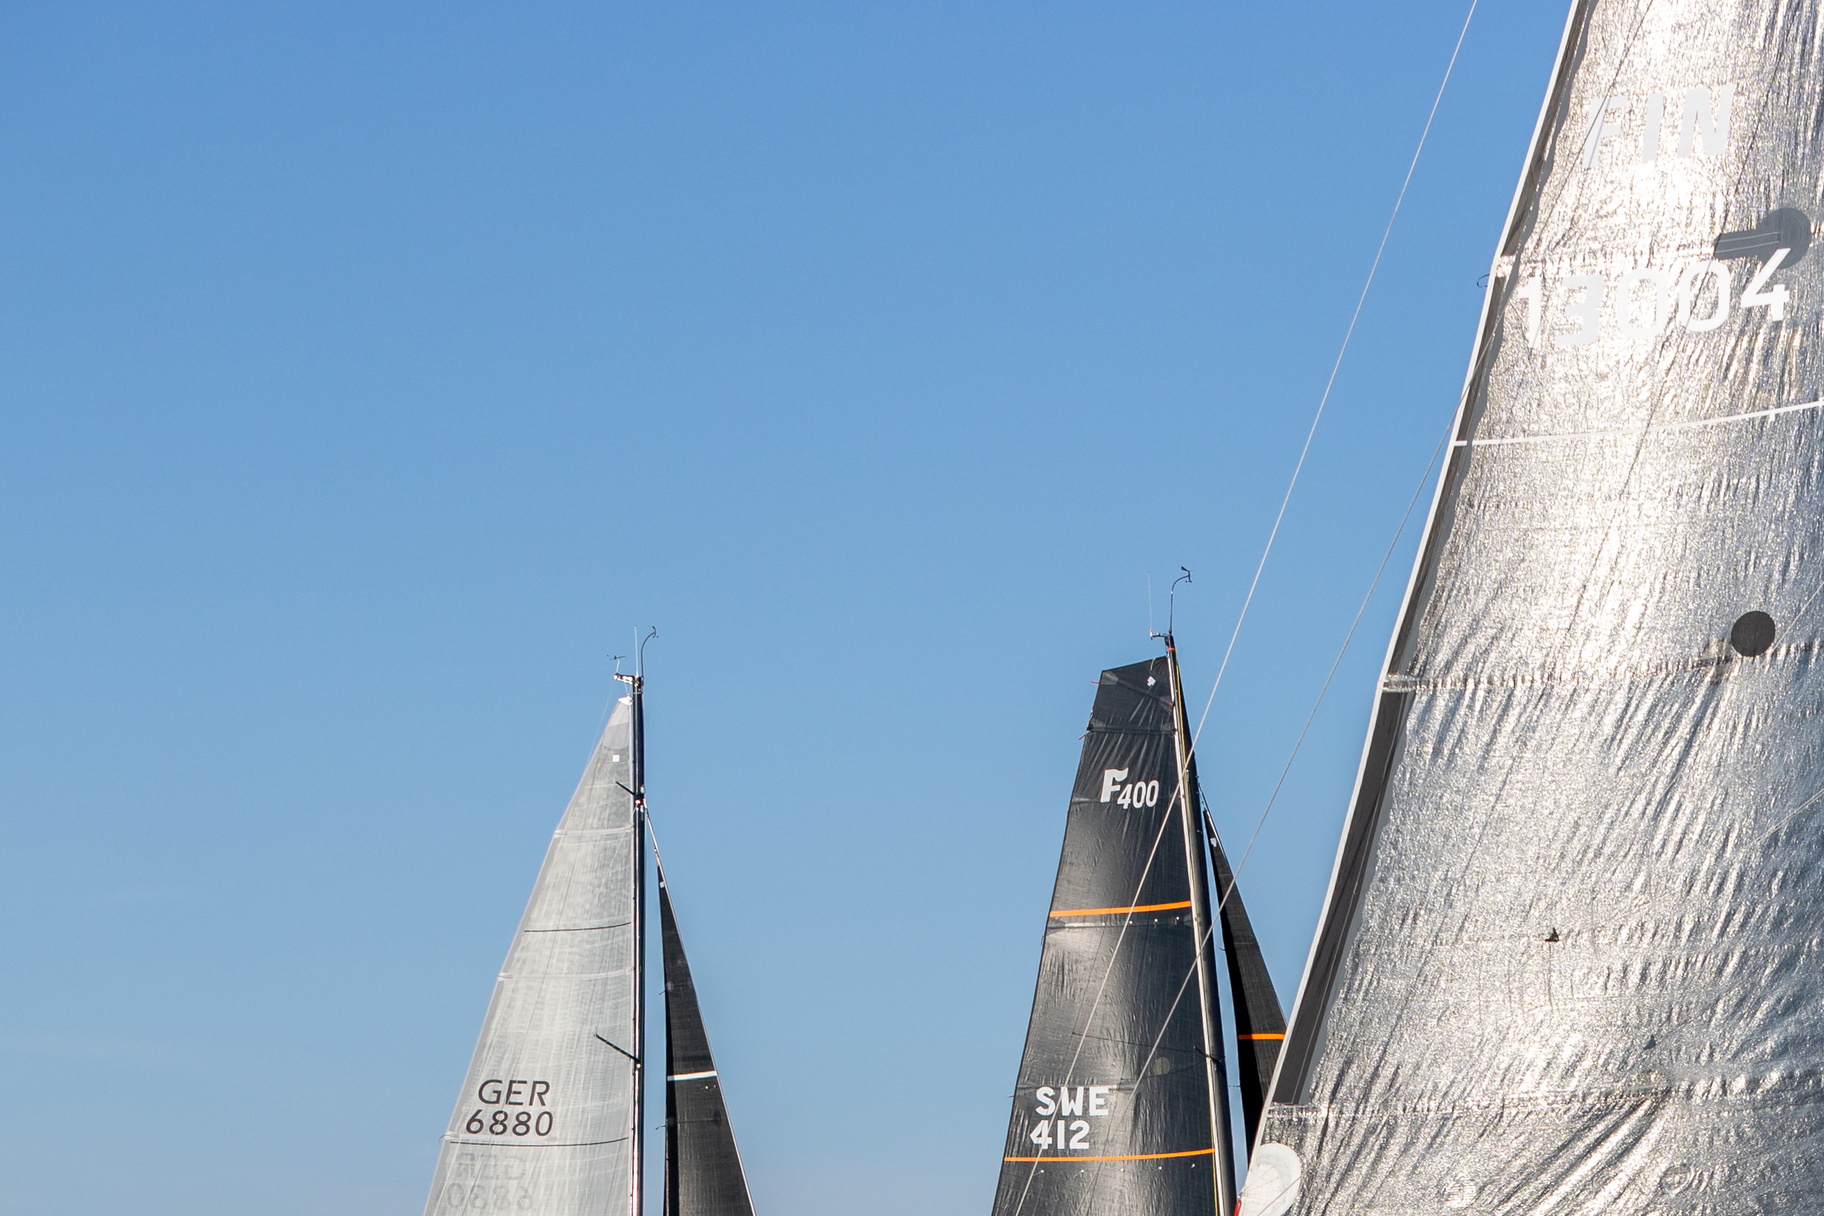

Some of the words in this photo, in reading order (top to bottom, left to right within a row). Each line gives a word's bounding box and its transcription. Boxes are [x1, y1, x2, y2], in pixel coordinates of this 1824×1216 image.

[1582, 84, 1735, 169] FIN
[1518, 248, 1791, 350] 13004
[1100, 767, 1160, 810] F400
[478, 1079, 551, 1107] GER
[1035, 1085, 1109, 1117] SWE
[465, 1109, 554, 1137] 6880
[1029, 1119, 1090, 1150] 412
